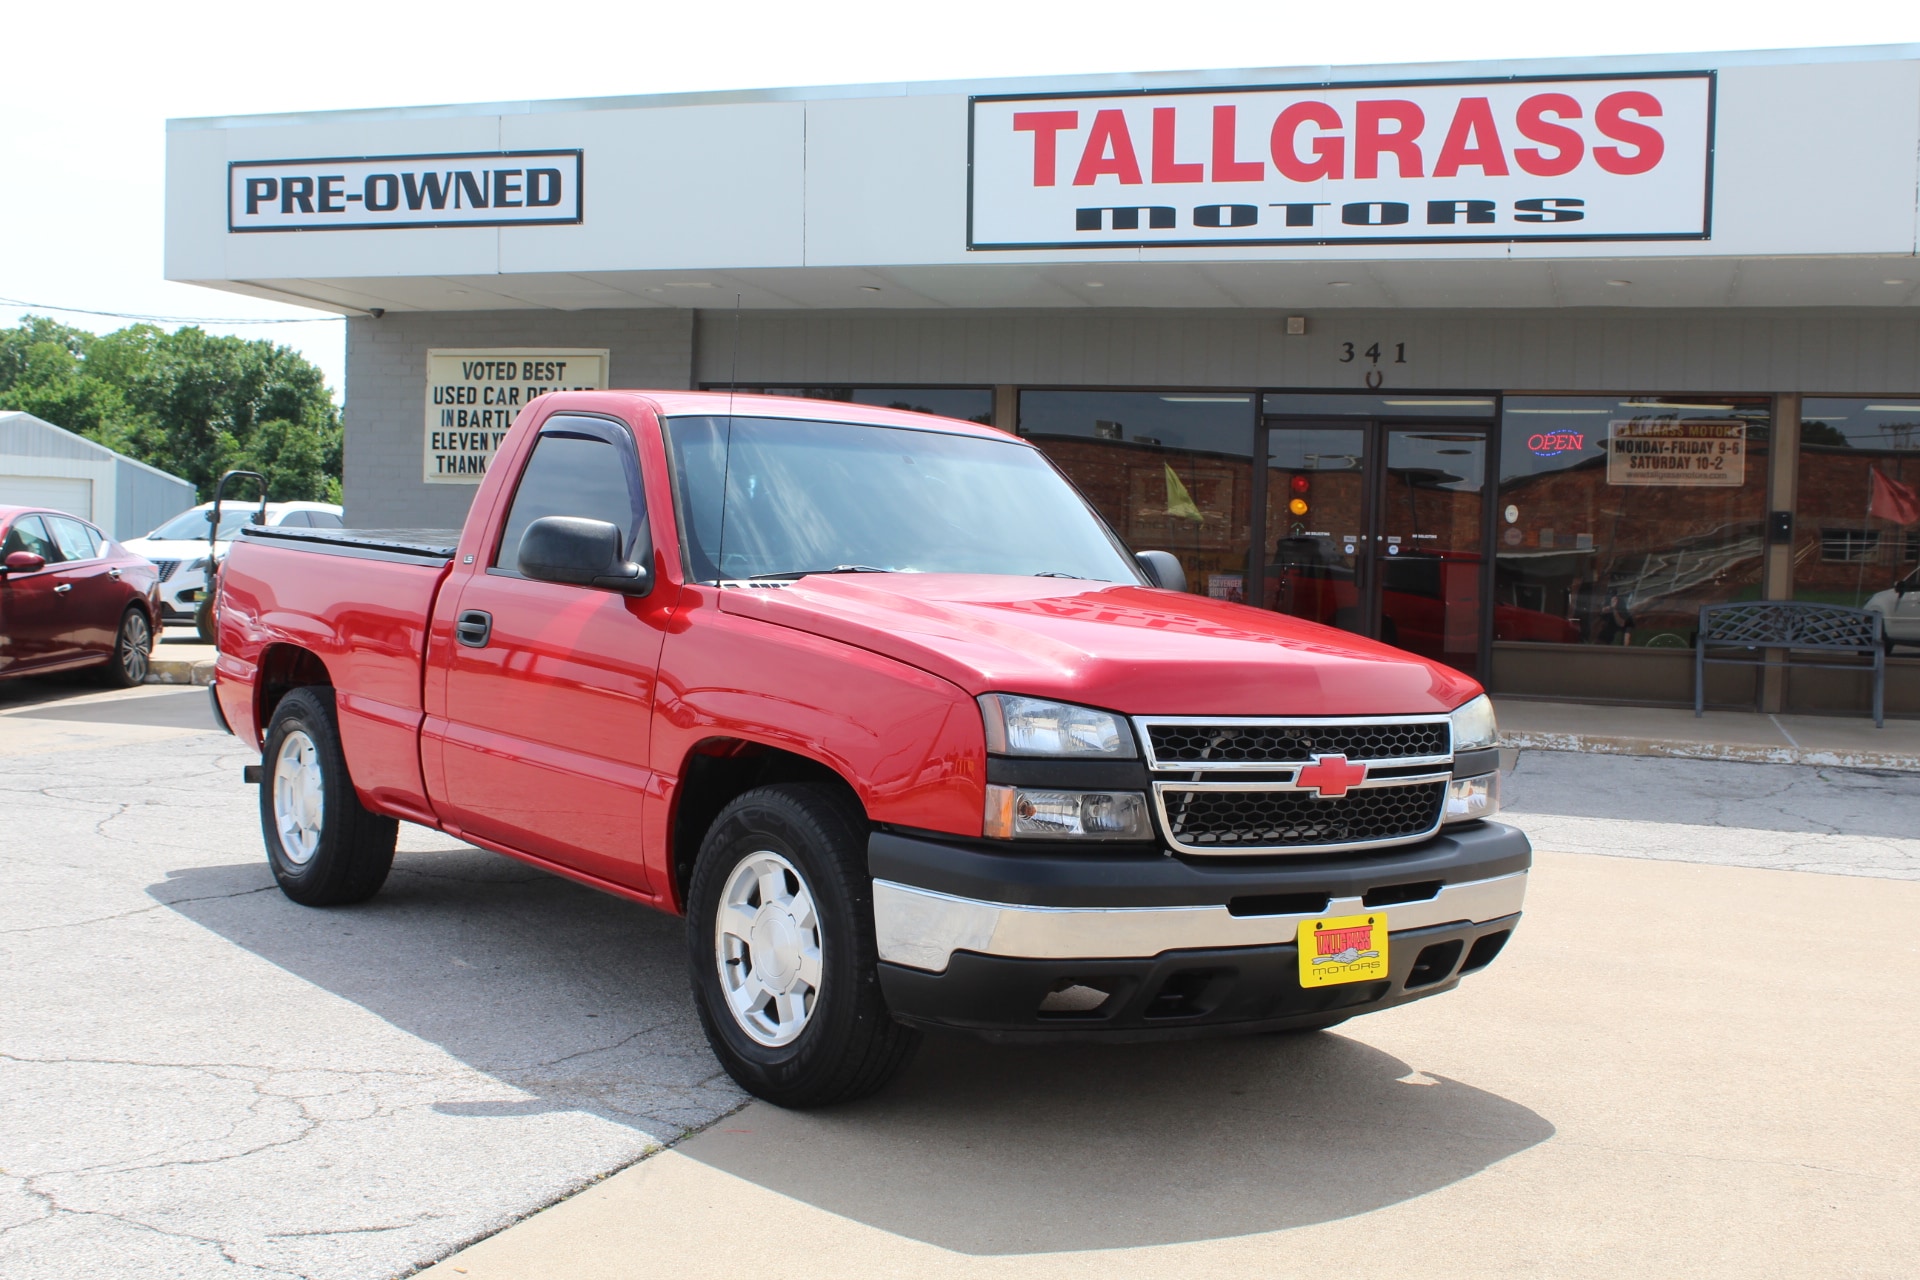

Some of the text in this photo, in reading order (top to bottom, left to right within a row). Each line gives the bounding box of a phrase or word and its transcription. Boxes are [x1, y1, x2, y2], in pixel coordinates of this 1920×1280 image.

[1012, 90, 1666, 188] TALLGRASS
[245, 167, 562, 215] PRE-OWNED
[1075, 197, 1586, 231] MOTORS
[1338, 341, 1407, 364] 341
[462, 361, 567, 381] VOTED BEST
[433, 386, 477, 405] USED
[483, 386, 519, 405] CAR
[441, 409, 454, 427] IN
[432, 432, 488, 451] ELEVEN
[1527, 433, 1584, 450] OPEN
[1615, 440, 1739, 455] MONDAY-FRIDAY 9-6
[435, 455, 486, 474] THANK
[1630, 456, 1723, 470] SATURDAY 10-2
[1312, 961, 1381, 976] MOTORS
